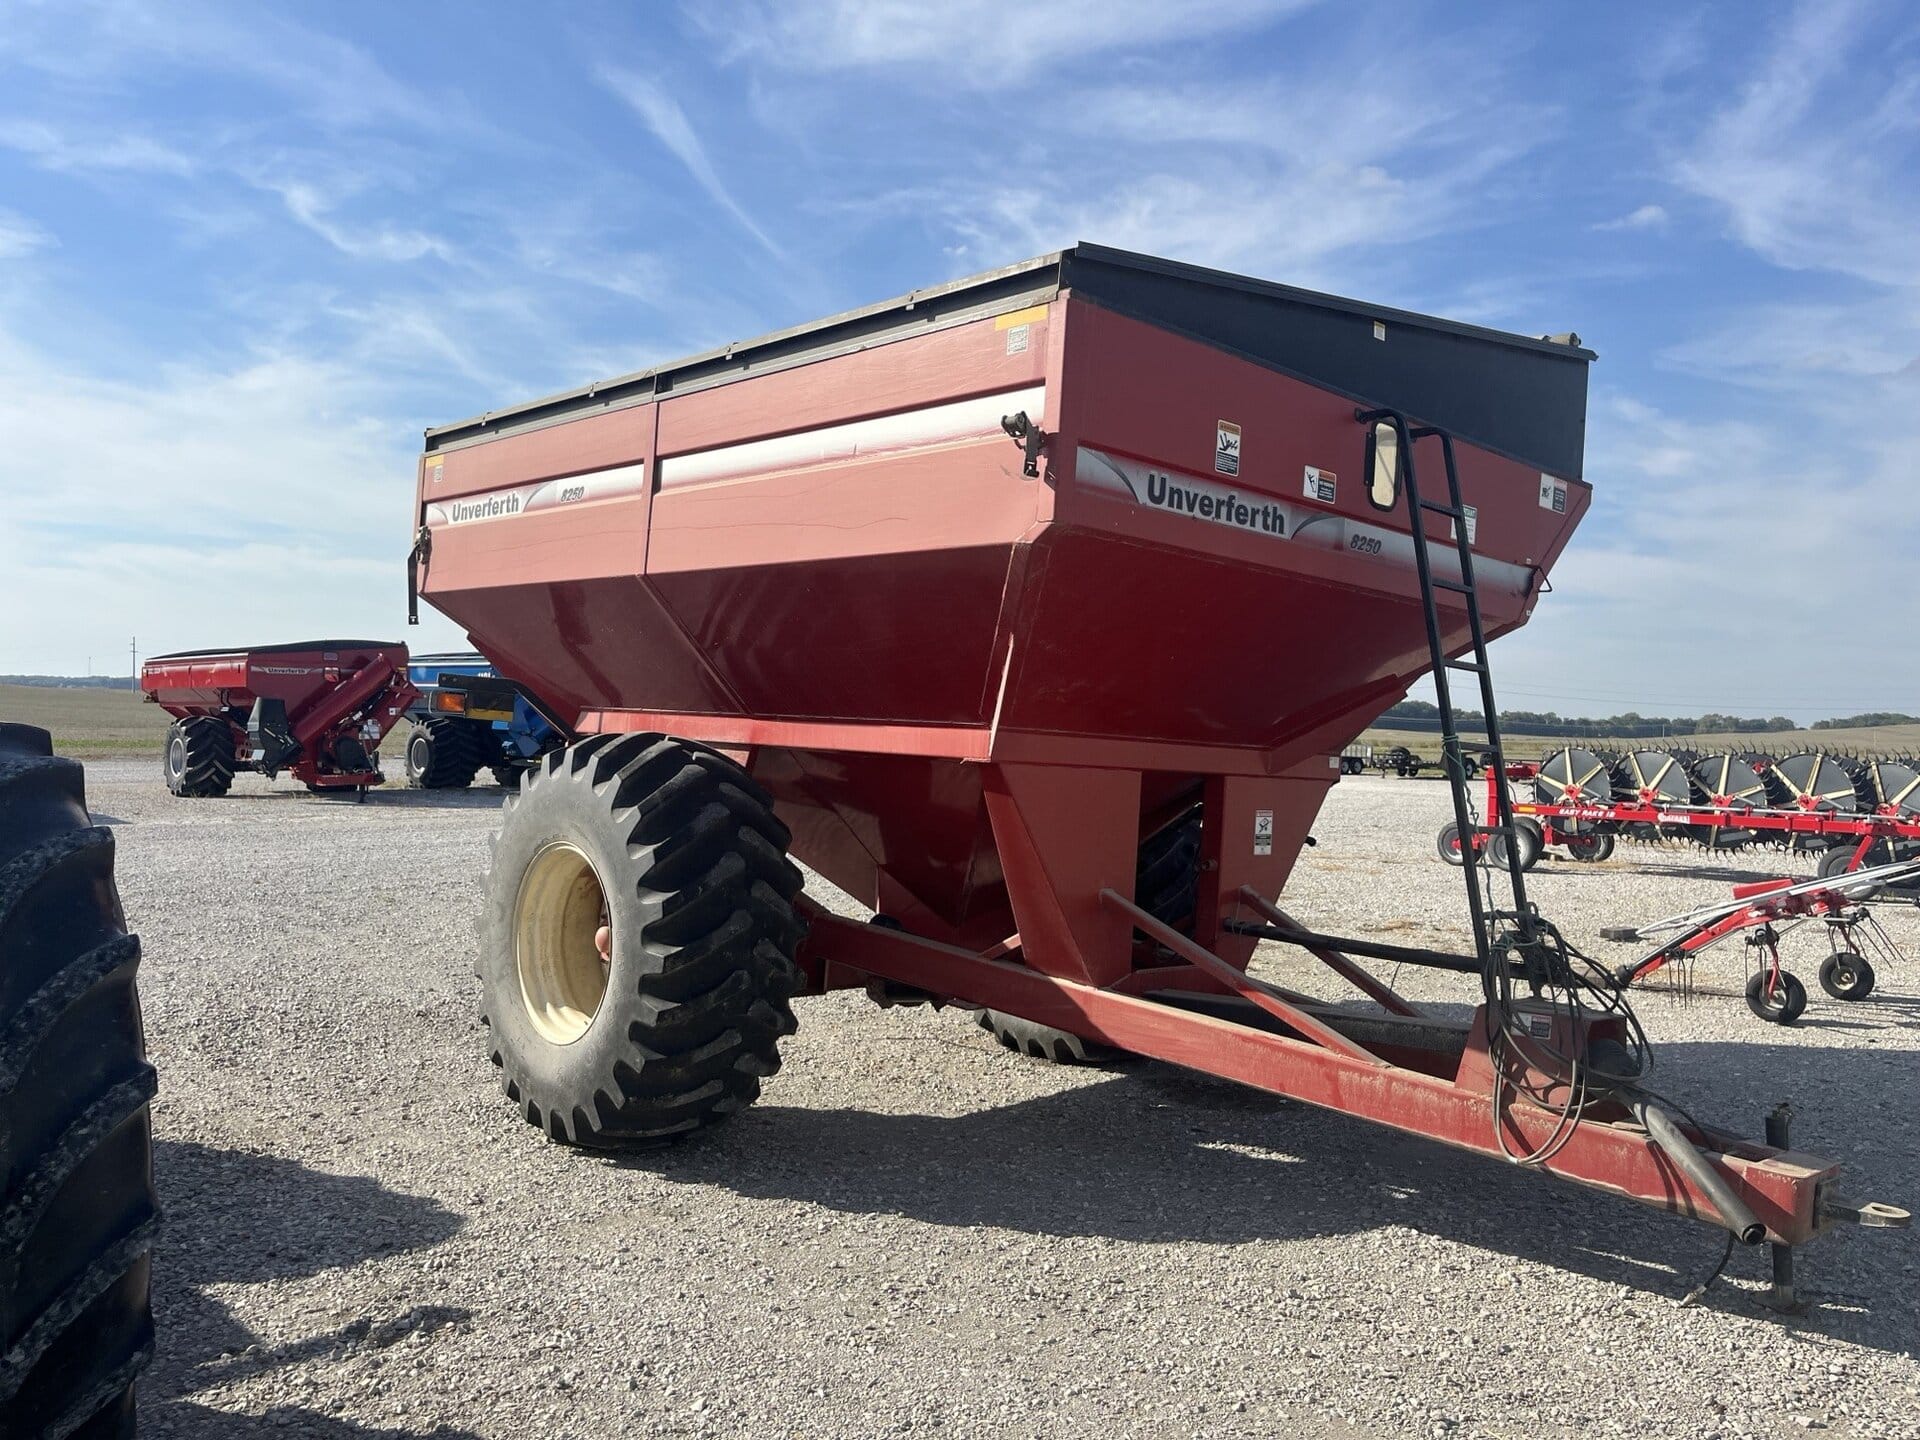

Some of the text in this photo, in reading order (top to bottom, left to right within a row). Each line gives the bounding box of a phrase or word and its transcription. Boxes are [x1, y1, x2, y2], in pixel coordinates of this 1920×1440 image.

[452, 486, 585, 522] Unverferth 8250
[1148, 473, 1286, 535] Unverferth
[1350, 533, 1382, 555] 8250
